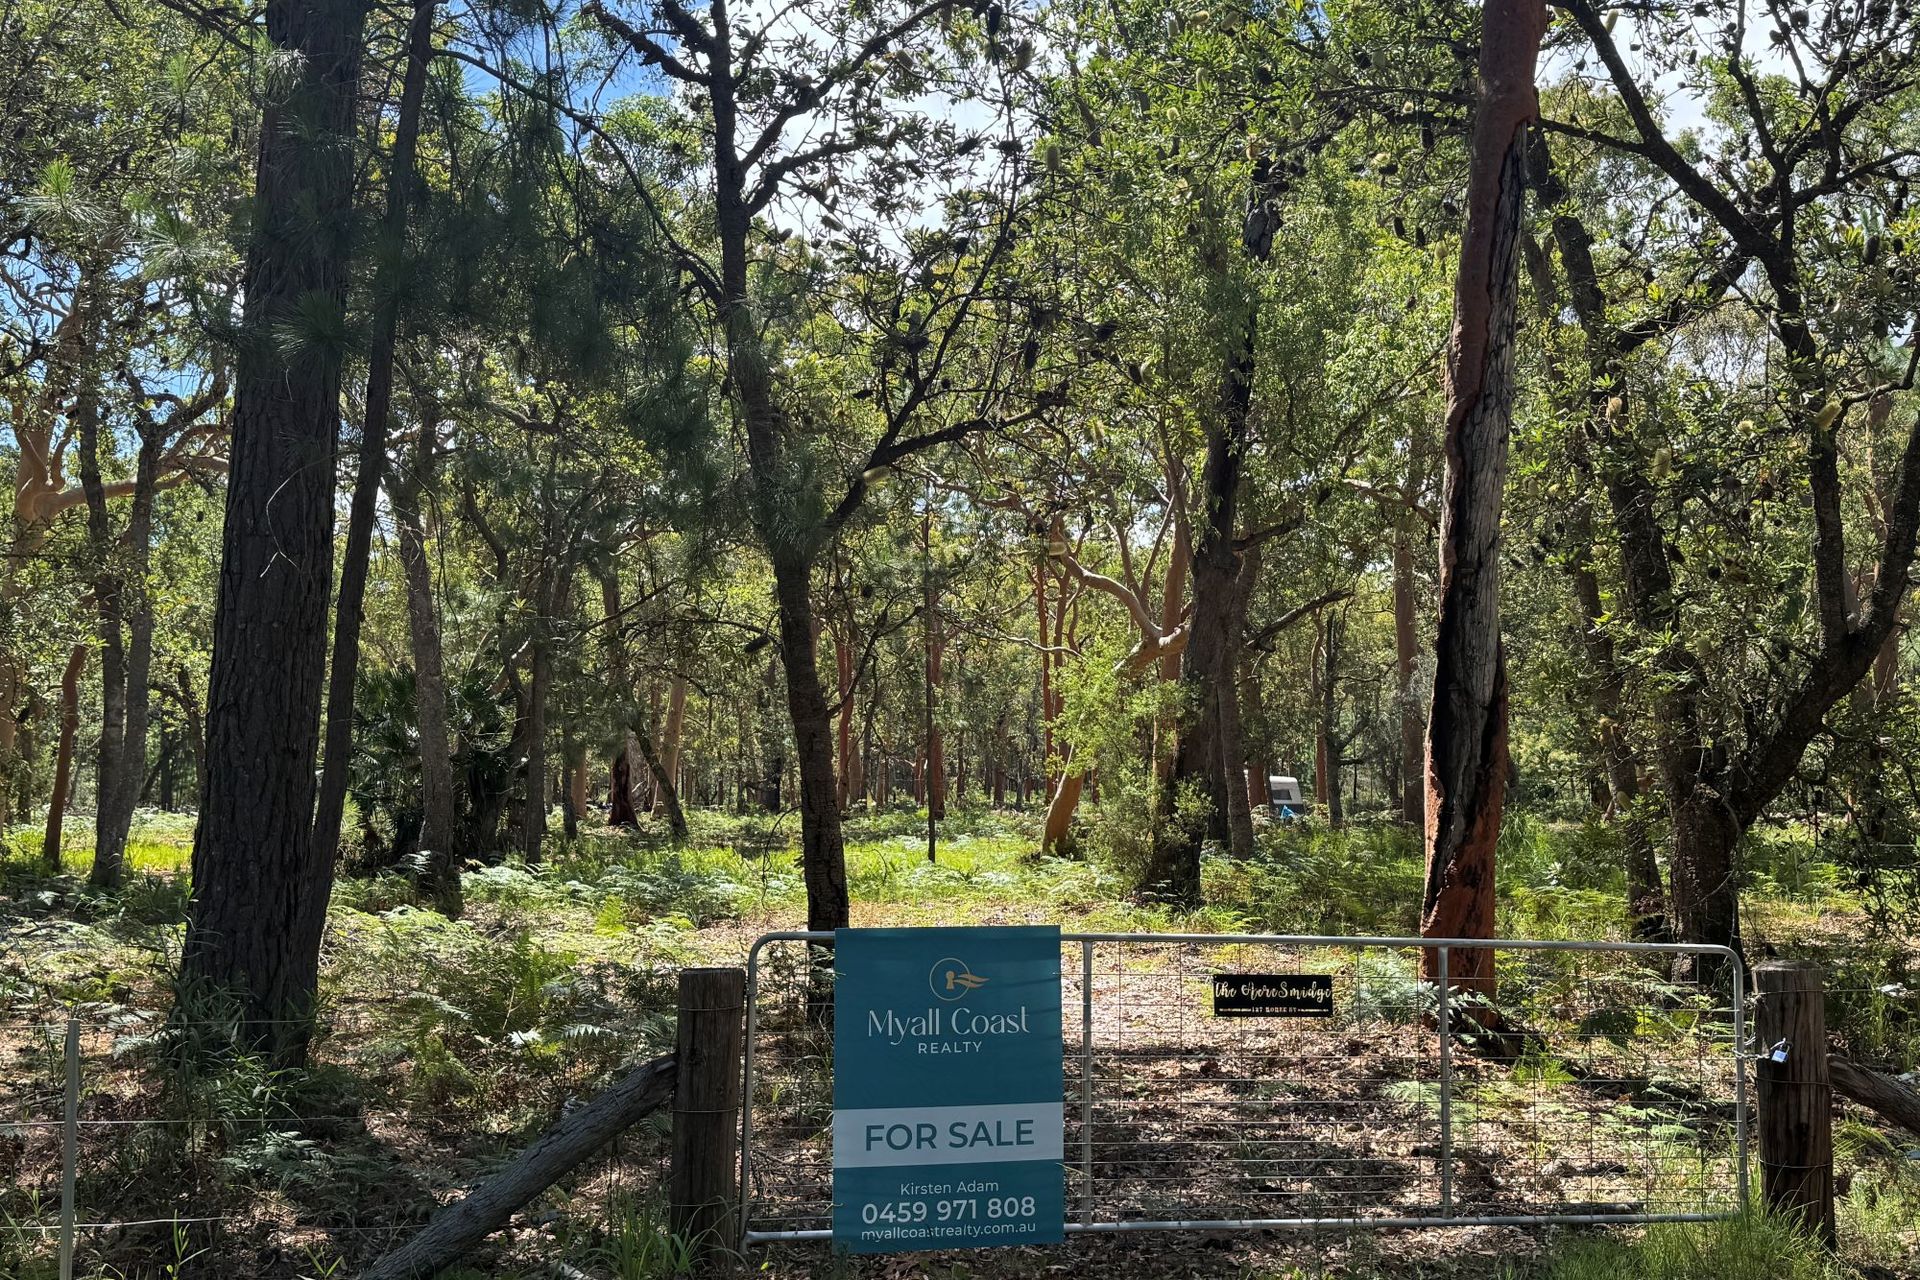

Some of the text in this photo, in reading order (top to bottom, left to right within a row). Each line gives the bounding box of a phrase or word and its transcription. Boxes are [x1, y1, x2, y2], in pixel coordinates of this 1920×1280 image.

[868, 1005, 1030, 1046] Myall Coast
[918, 1041, 982, 1054] REALTY
[865, 1119, 1035, 1152] FOR SALE
[900, 1180, 999, 1196] Kirsten Adam
[862, 1196, 1036, 1224] 0459 971 808
[861, 1222, 1036, 1242] myallcoastrealty.com.au
